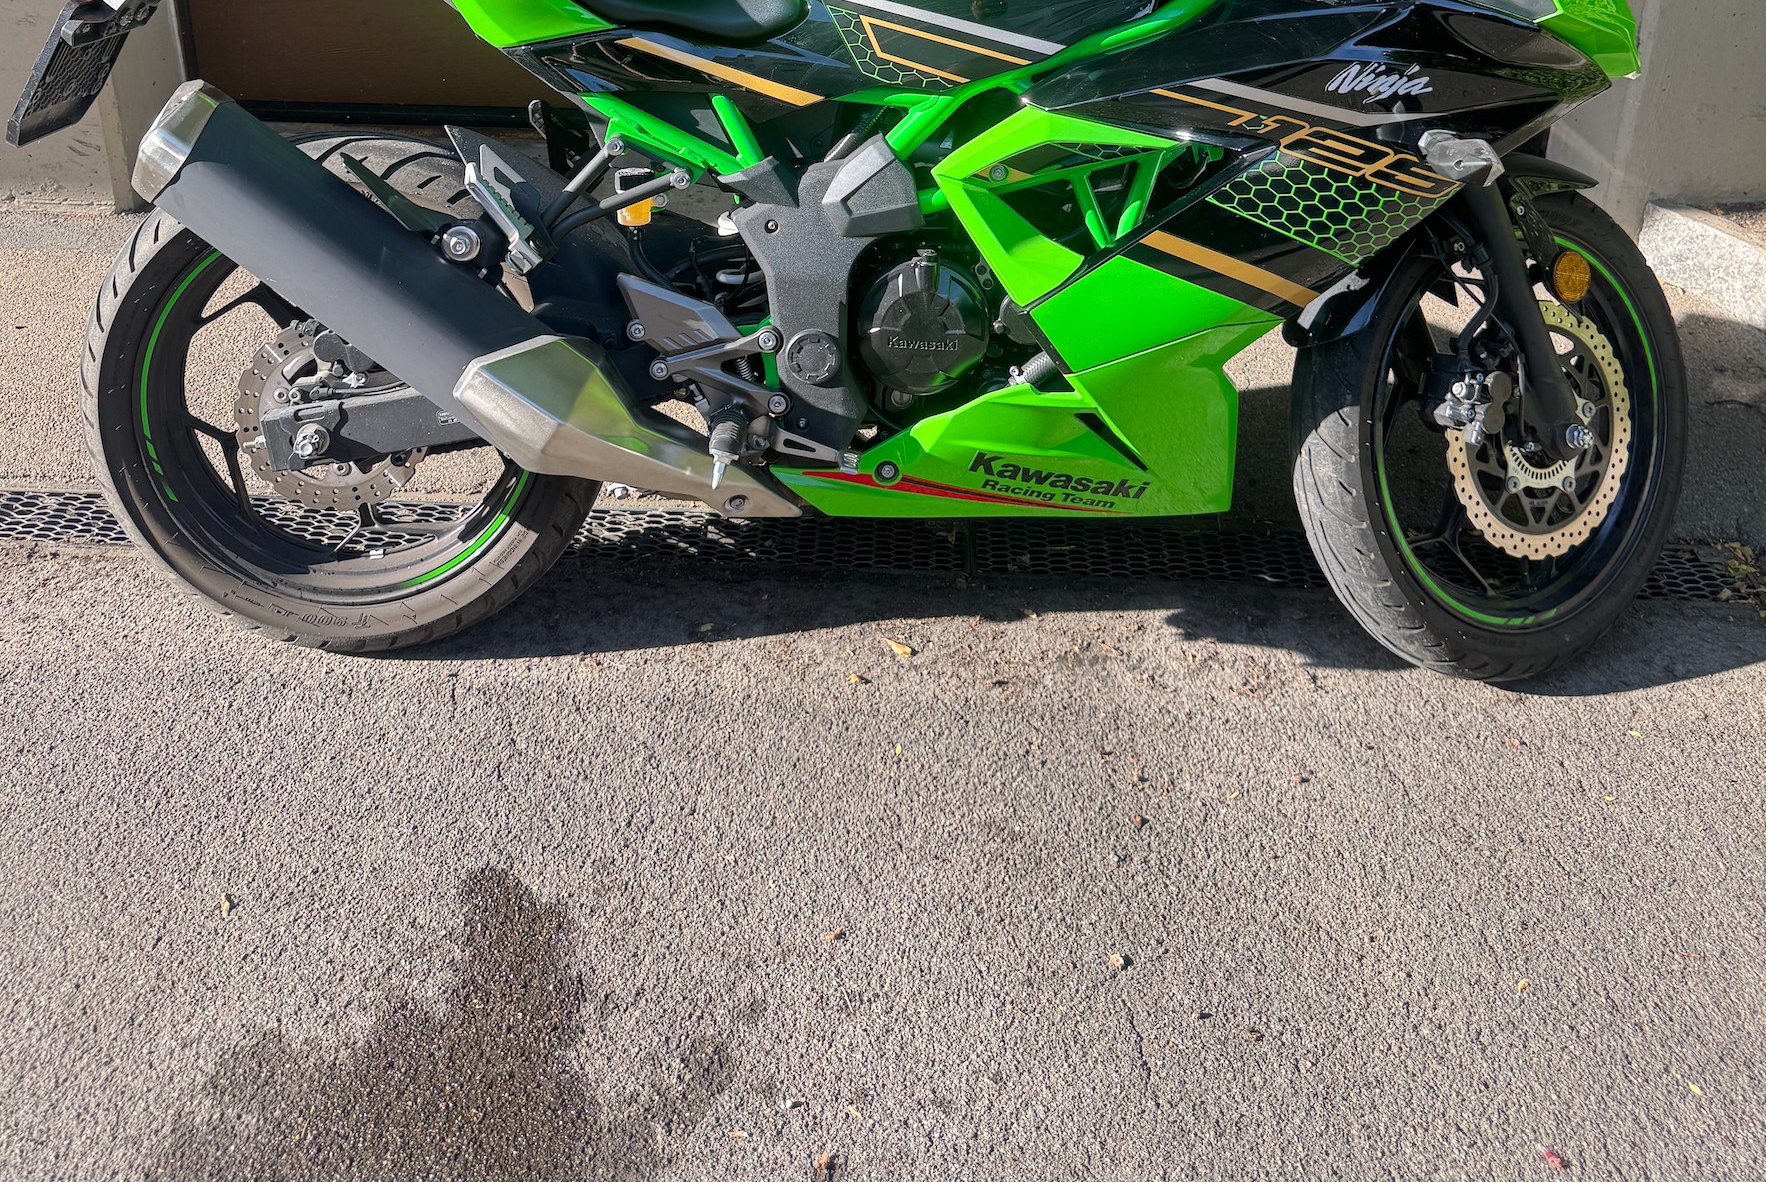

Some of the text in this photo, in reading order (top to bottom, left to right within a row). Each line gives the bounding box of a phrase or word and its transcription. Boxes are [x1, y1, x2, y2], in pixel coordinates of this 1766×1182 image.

[1324, 61, 1433, 105] Ninja
[887, 335, 960, 351] Kawasaki
[968, 450, 1150, 499] Kawasaki
[981, 478, 1116, 509] Racing Team
